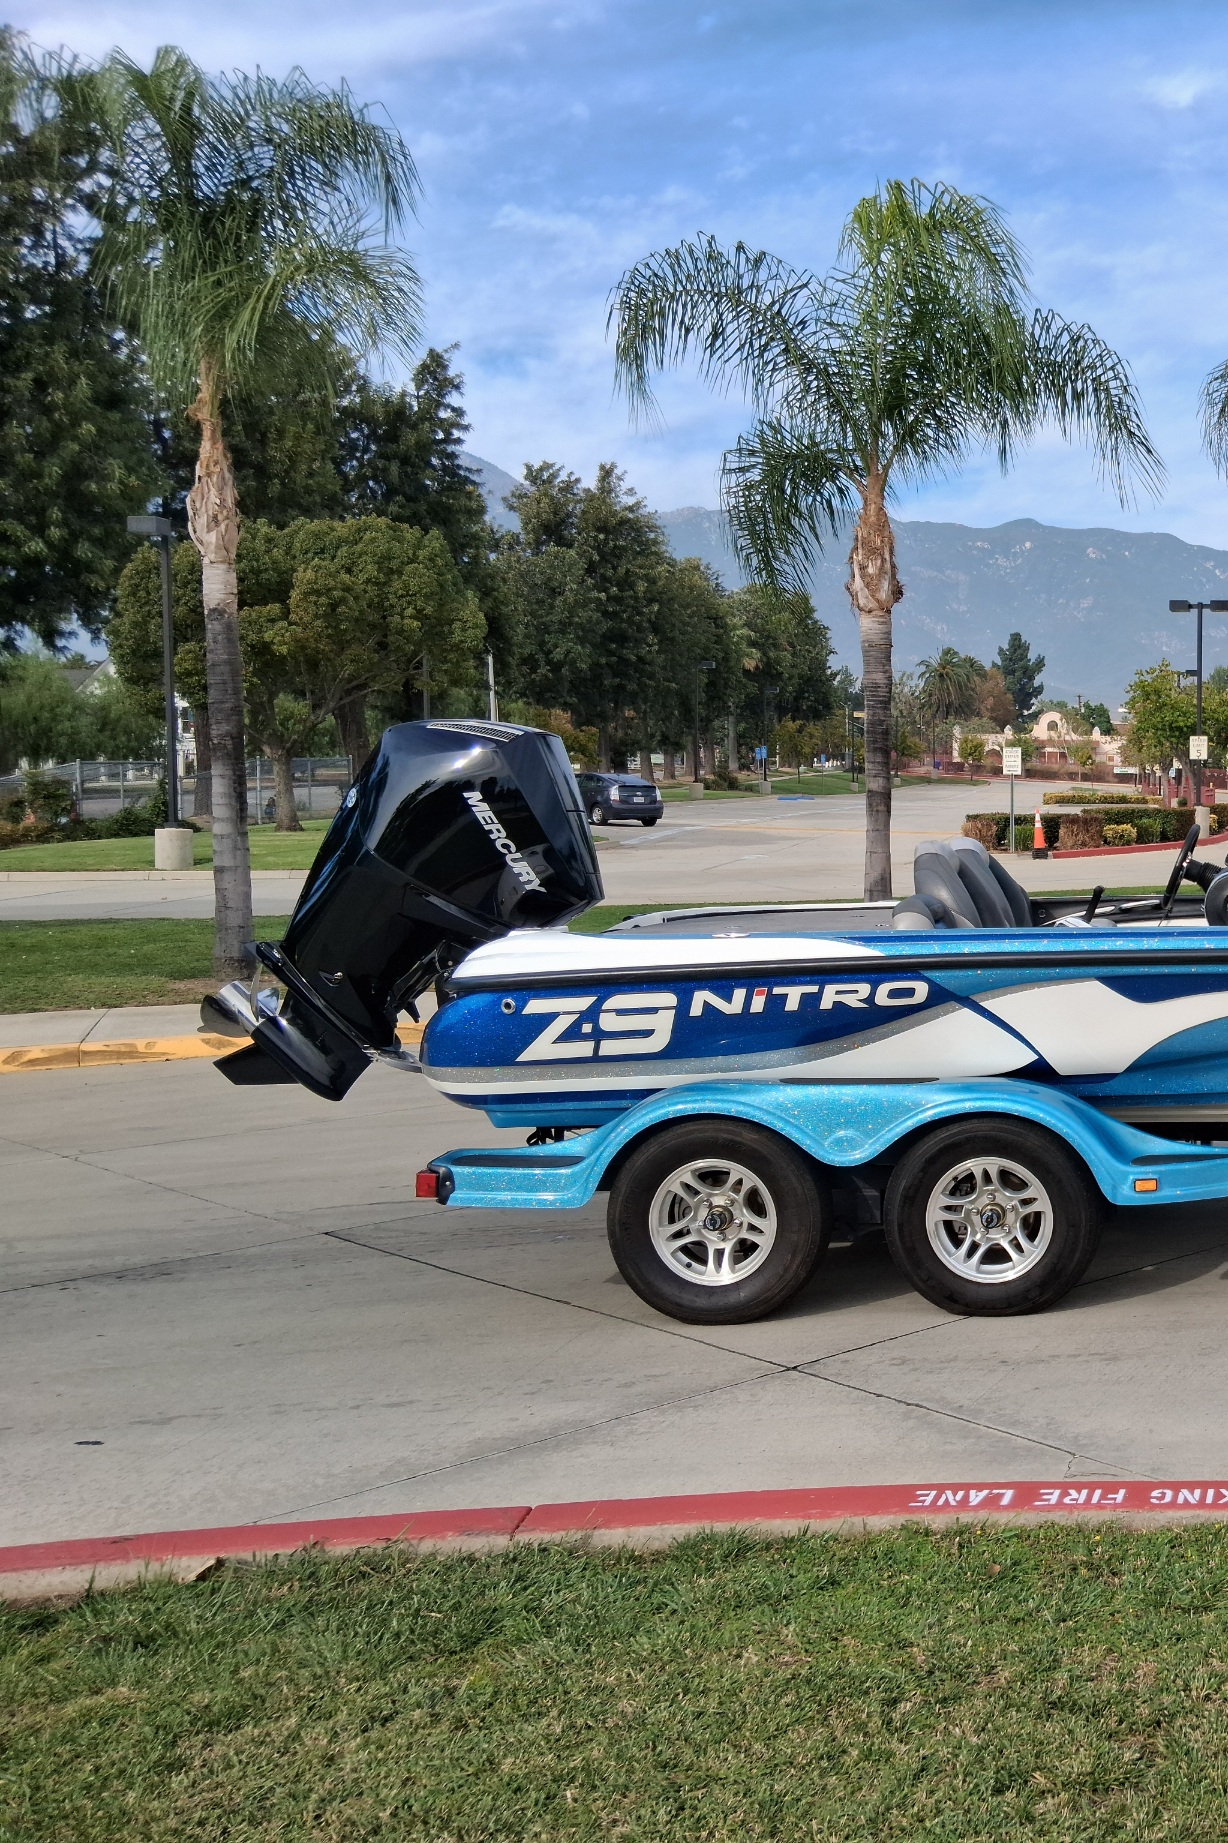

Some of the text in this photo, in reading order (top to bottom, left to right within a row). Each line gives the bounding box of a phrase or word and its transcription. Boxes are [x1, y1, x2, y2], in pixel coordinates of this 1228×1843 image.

[1196, 749, 1202, 758] 5
[462, 791, 547, 893] MERCURY
[908, 1488, 1016, 1507] LANE
[1034, 1488, 1127, 1506] FIRE
